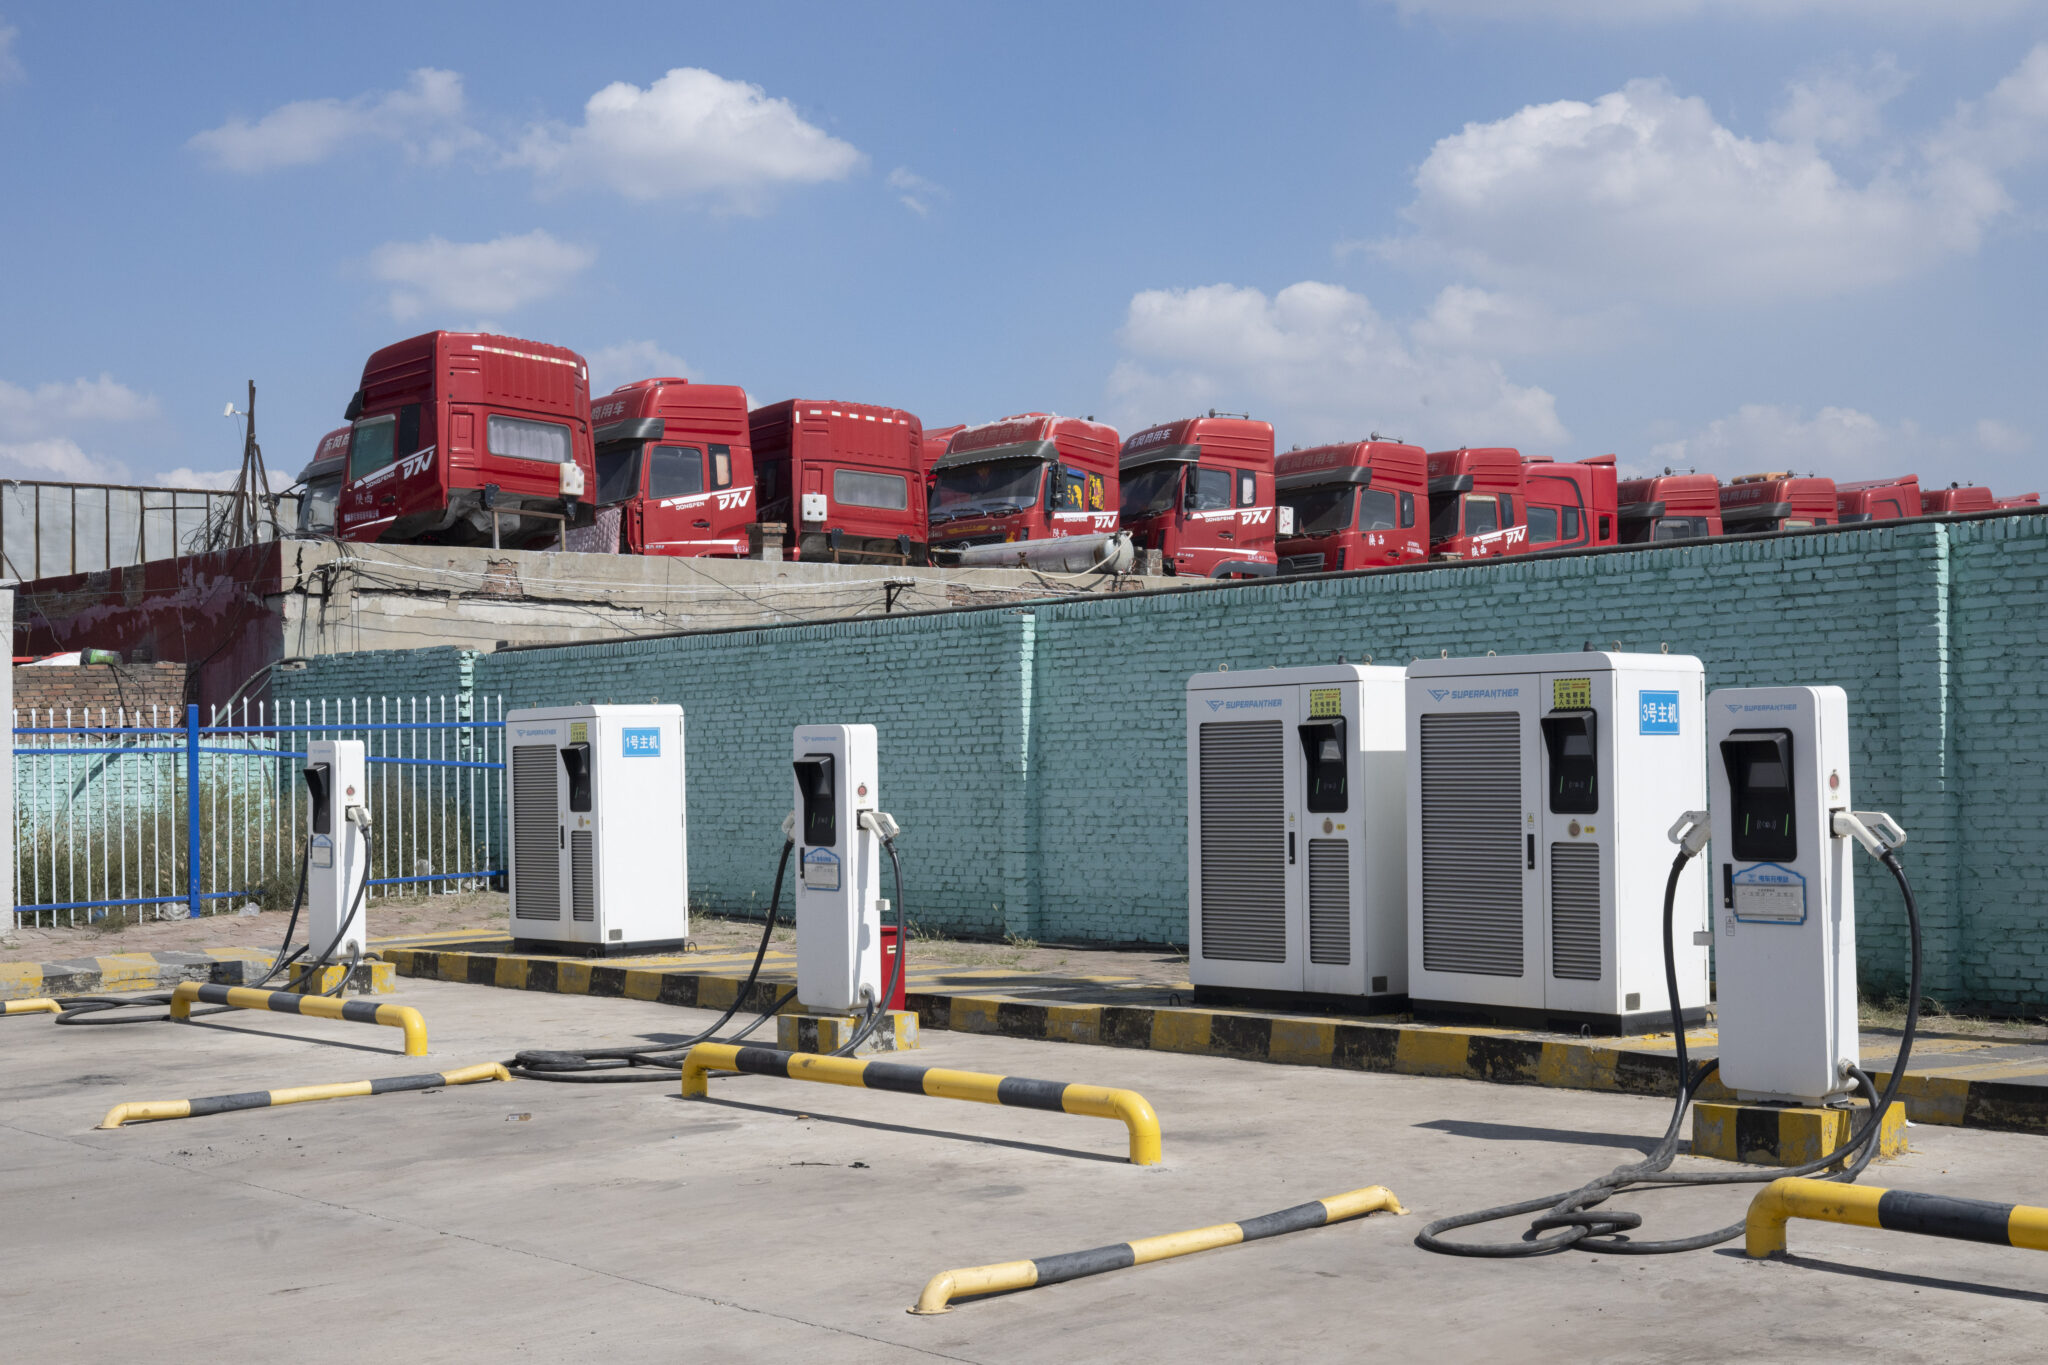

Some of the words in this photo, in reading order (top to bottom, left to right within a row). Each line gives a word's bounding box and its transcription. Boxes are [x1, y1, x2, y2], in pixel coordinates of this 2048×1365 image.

[1451, 687, 1519, 699] SUPERPANTHER
[1226, 698, 1282, 709] SUPERPANTHER
[1744, 703, 1797, 712] SUPERPANTHER
[1642, 702, 1678, 724] 3号主机
[626, 735, 659, 750] 1号主机
